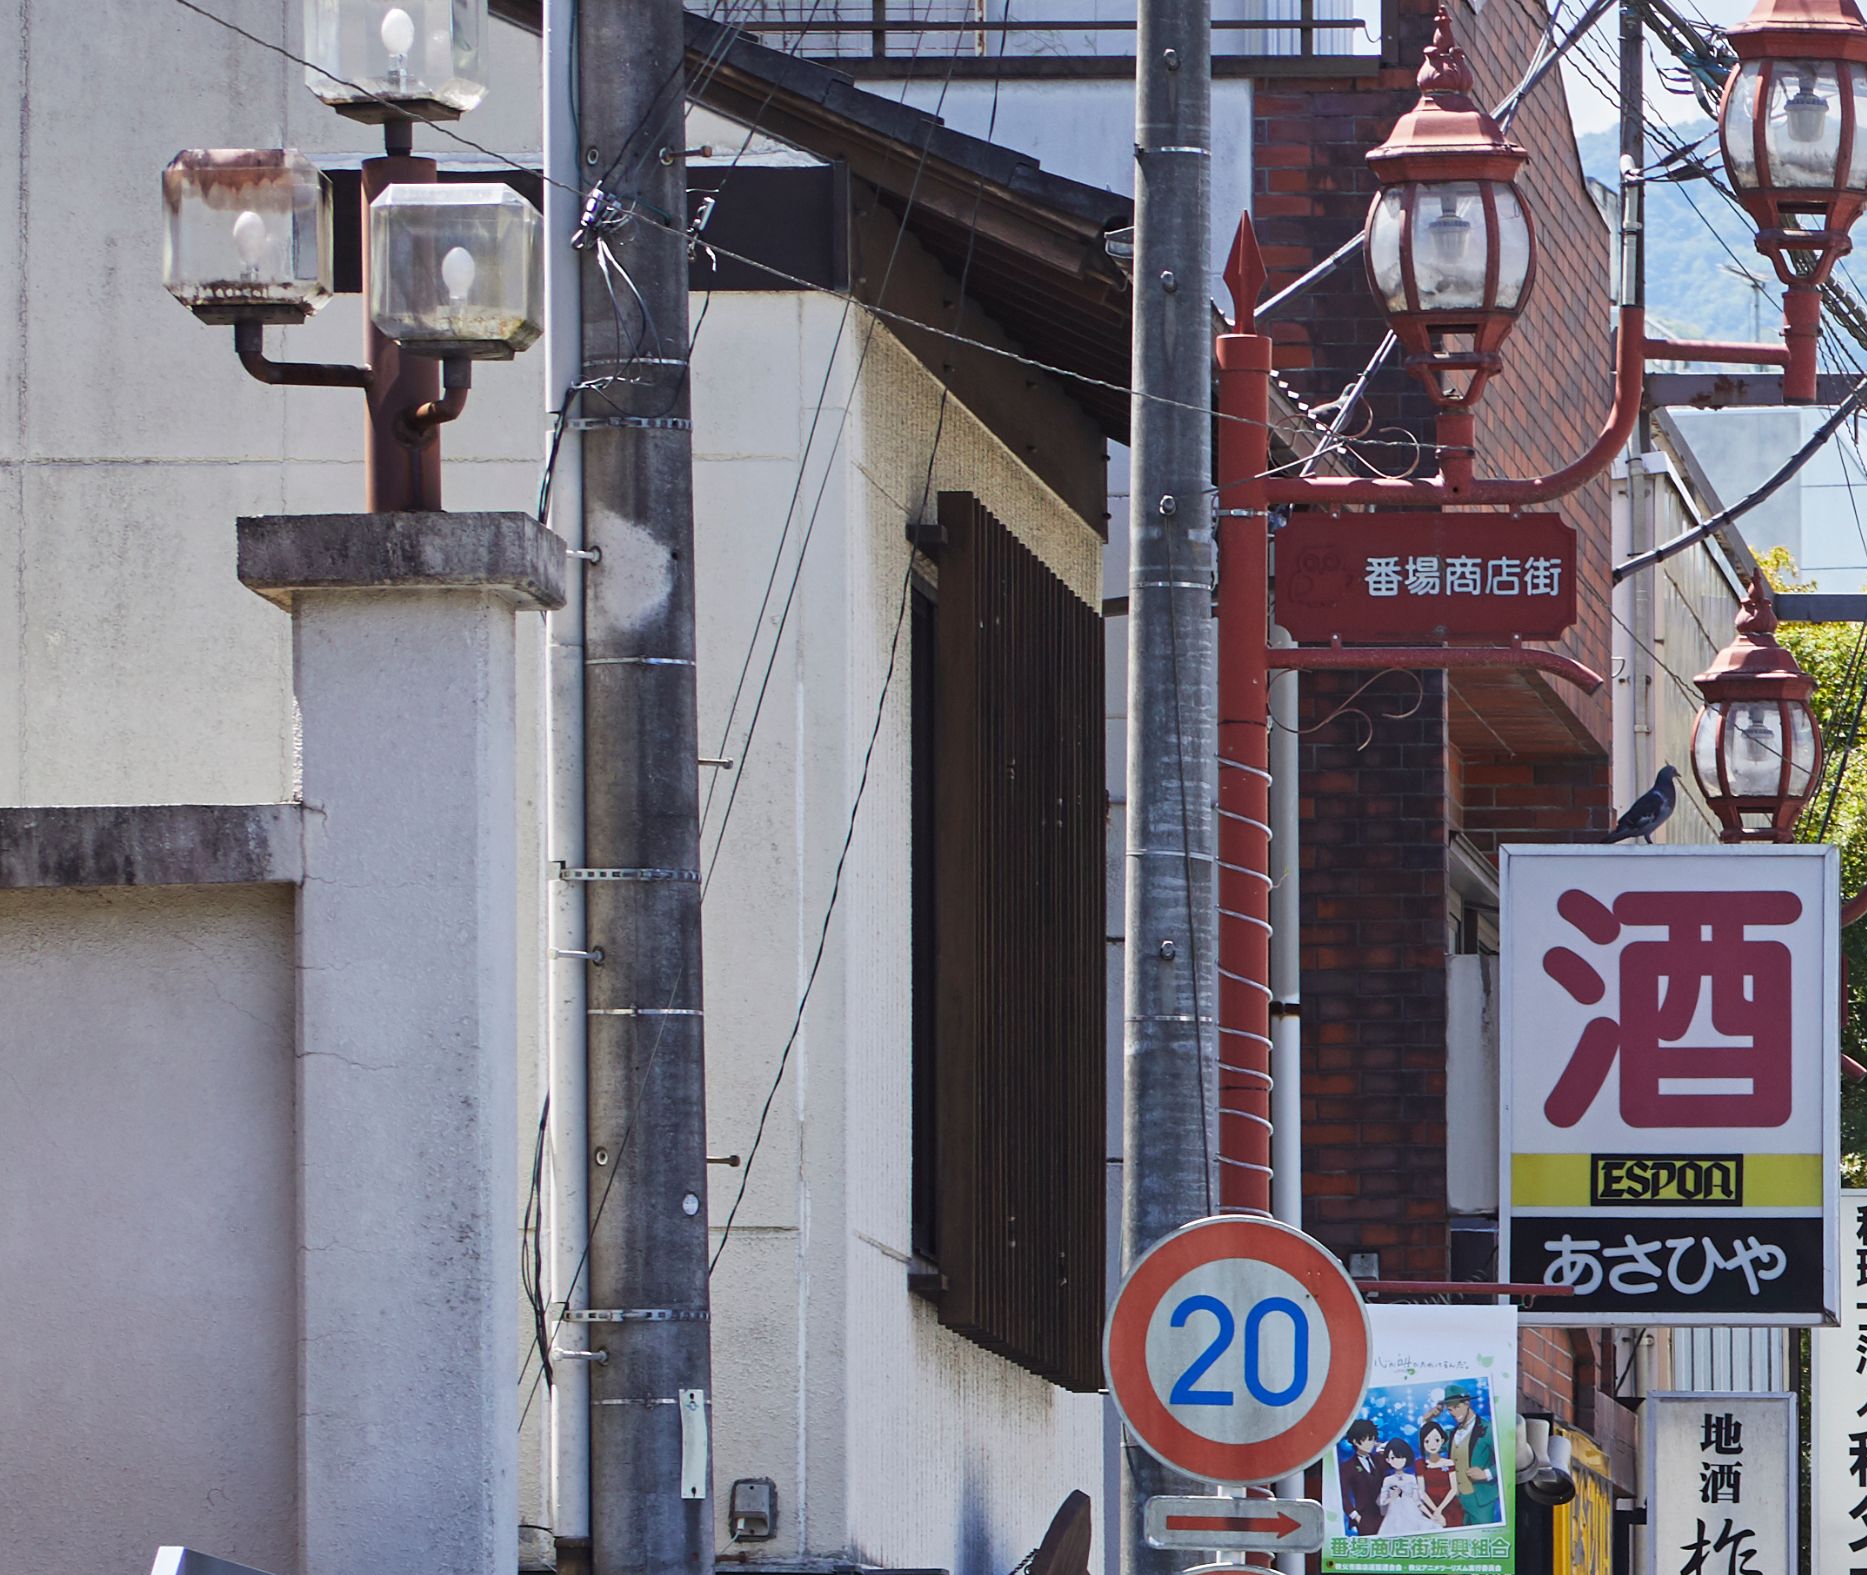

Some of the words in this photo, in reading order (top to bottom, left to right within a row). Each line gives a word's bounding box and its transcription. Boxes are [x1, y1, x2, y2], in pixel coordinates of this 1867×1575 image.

[1365, 557, 1562, 597] 番場商店街
[1543, 889, 1802, 1128] 酒
[1599, 1160, 1734, 1198] ESPOA
[1543, 1233, 1787, 1296] あさひや
[1169, 1295, 1310, 1406] 20
[1700, 1414, 1743, 1504] 地酒
[1330, 1537, 1511, 1559] 番場商店街振興組合
